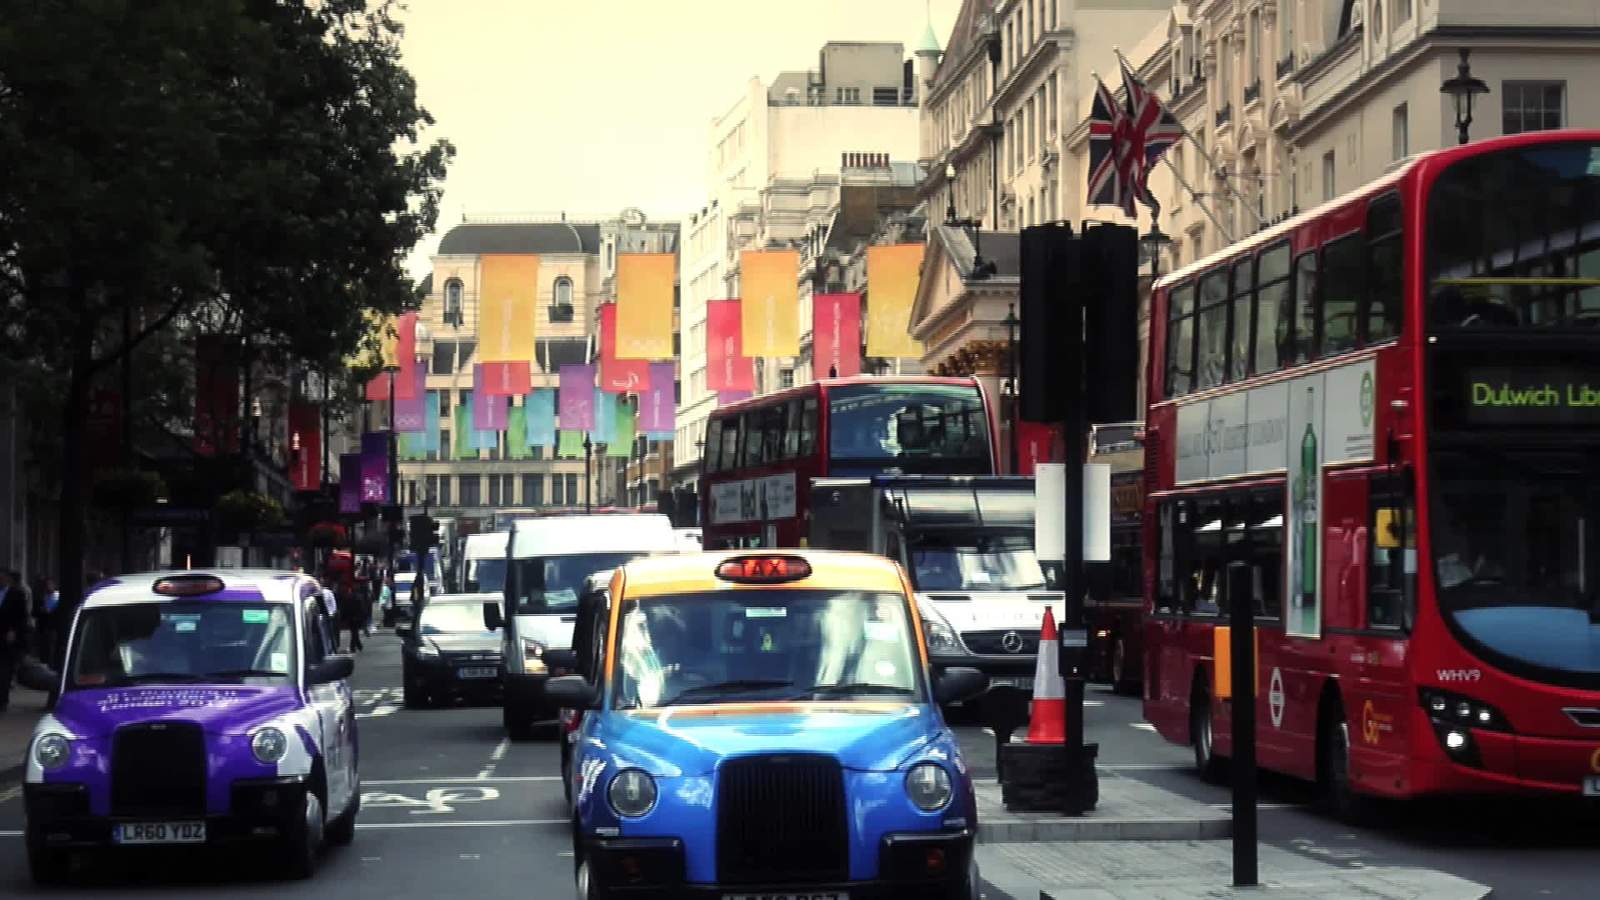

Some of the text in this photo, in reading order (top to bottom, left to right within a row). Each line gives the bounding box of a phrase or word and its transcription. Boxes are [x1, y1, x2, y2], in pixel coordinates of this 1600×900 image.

[1472, 383, 1559, 406] Dulwich
[1436, 669, 1480, 681] WHV9
[123, 823, 167, 841] LR60
